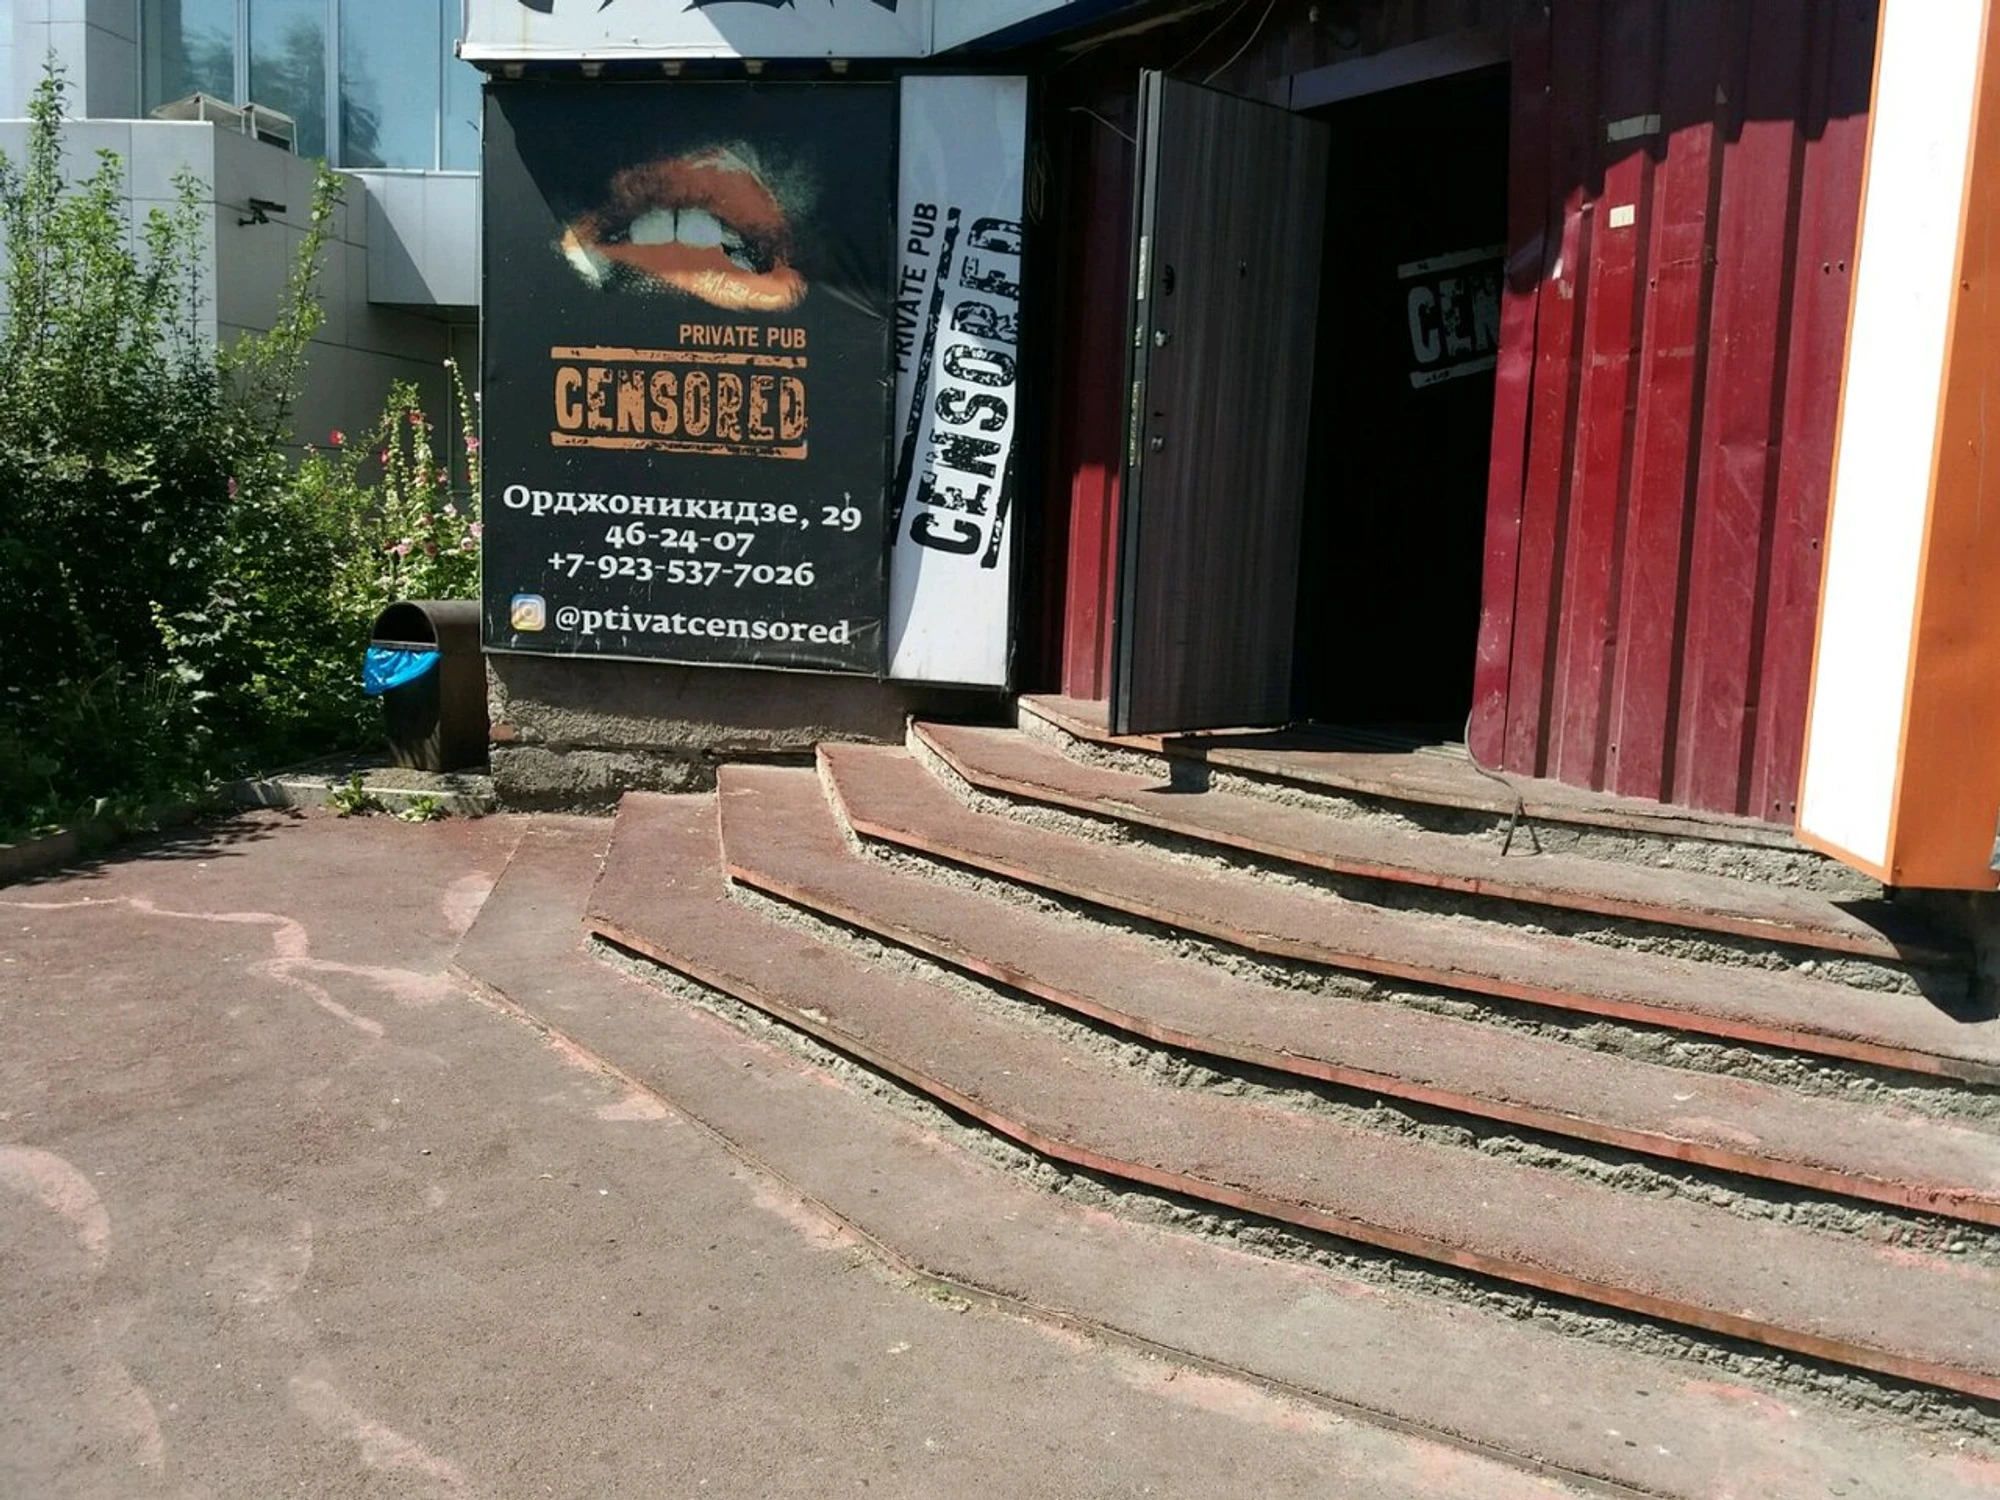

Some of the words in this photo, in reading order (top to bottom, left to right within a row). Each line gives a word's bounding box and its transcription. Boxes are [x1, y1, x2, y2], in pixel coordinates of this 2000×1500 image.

[907, 203, 938, 257] PUB
[679, 323, 759, 347] PRIVATE
[767, 327, 806, 349] PUB
[554, 366, 808, 442] CENSORED
[909, 217, 1022, 555] CENSORED
[502, 484, 810, 531] Орджоникидзе,
[821, 505, 863, 532] 29
[604, 521, 755, 557] 46-24-07
[547, 552, 815, 588] +7-923-537-7026
[555, 605, 851, 644] @ptivatcensored
